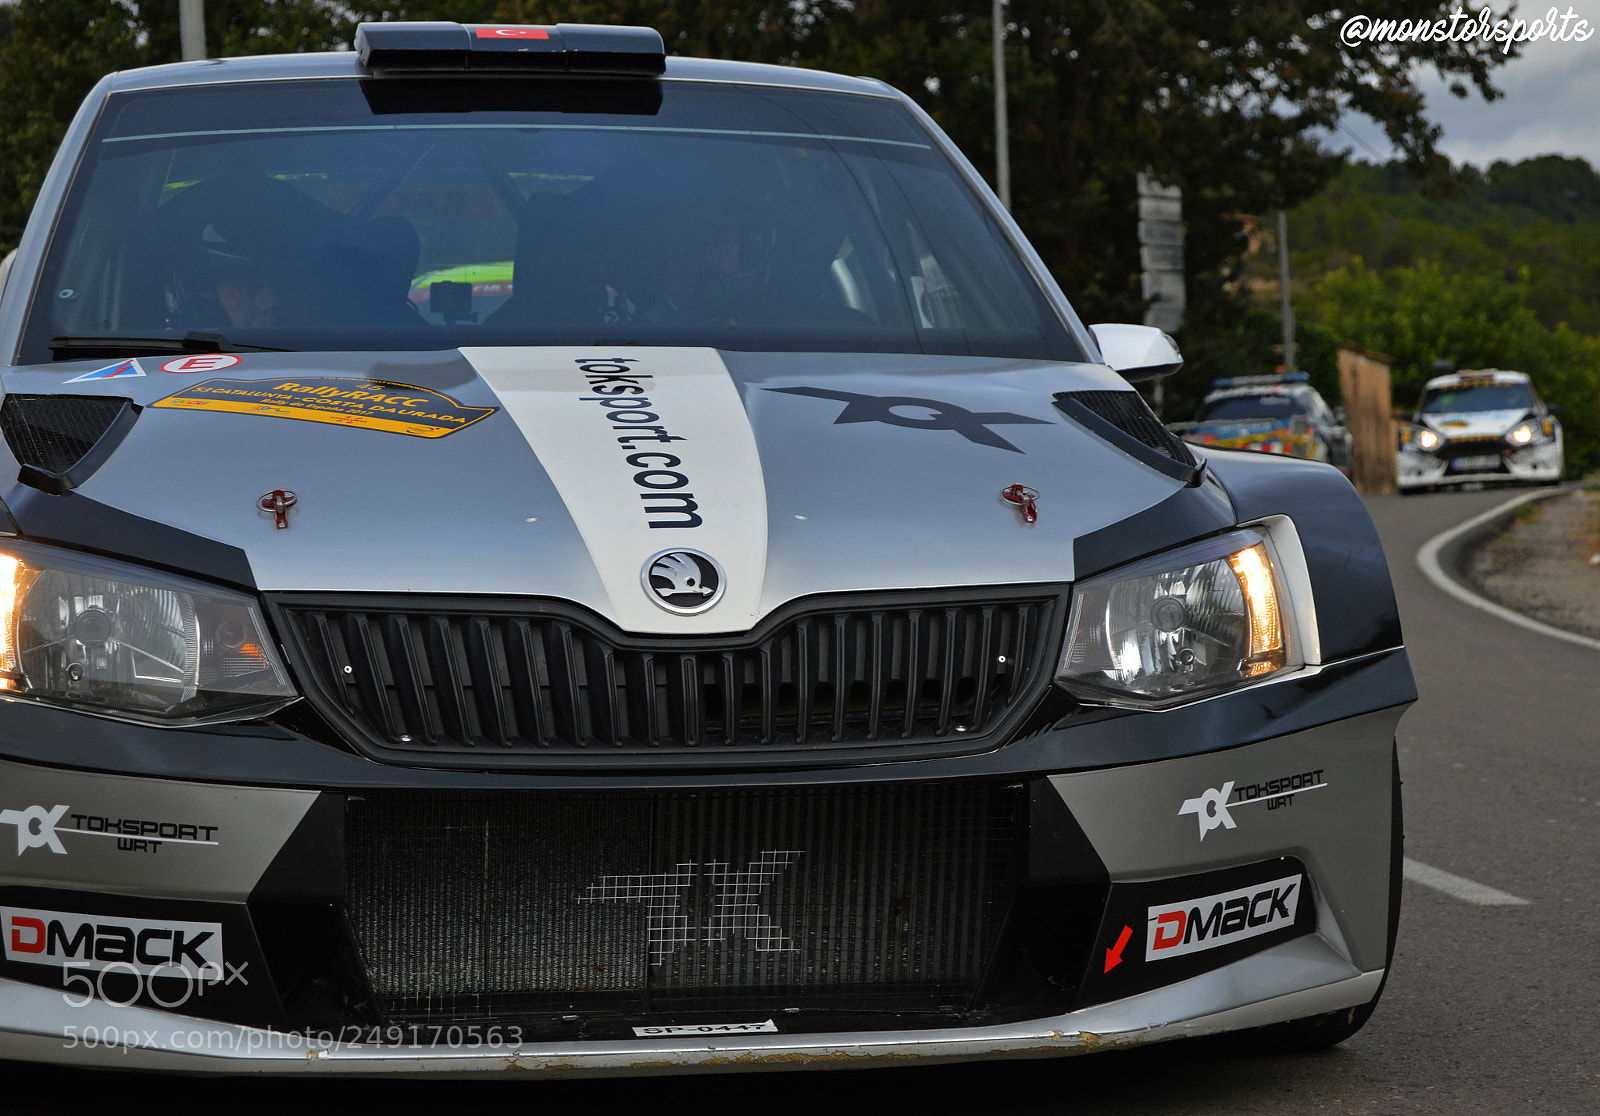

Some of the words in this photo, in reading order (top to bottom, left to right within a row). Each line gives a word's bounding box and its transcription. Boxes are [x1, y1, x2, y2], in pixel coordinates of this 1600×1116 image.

[179, 357, 223, 370] E
[273, 382, 429, 407] RallyRACC
[344, 408, 375, 416] 2017
[368, 405, 466, 424] DAURADA
[574, 357, 703, 529] toksport.com
[1234, 769, 1324, 802] TOKSPORT
[1267, 794, 1296, 811] WRT
[70, 813, 219, 841] TOKSPORT
[117, 838, 162, 853] WRT
